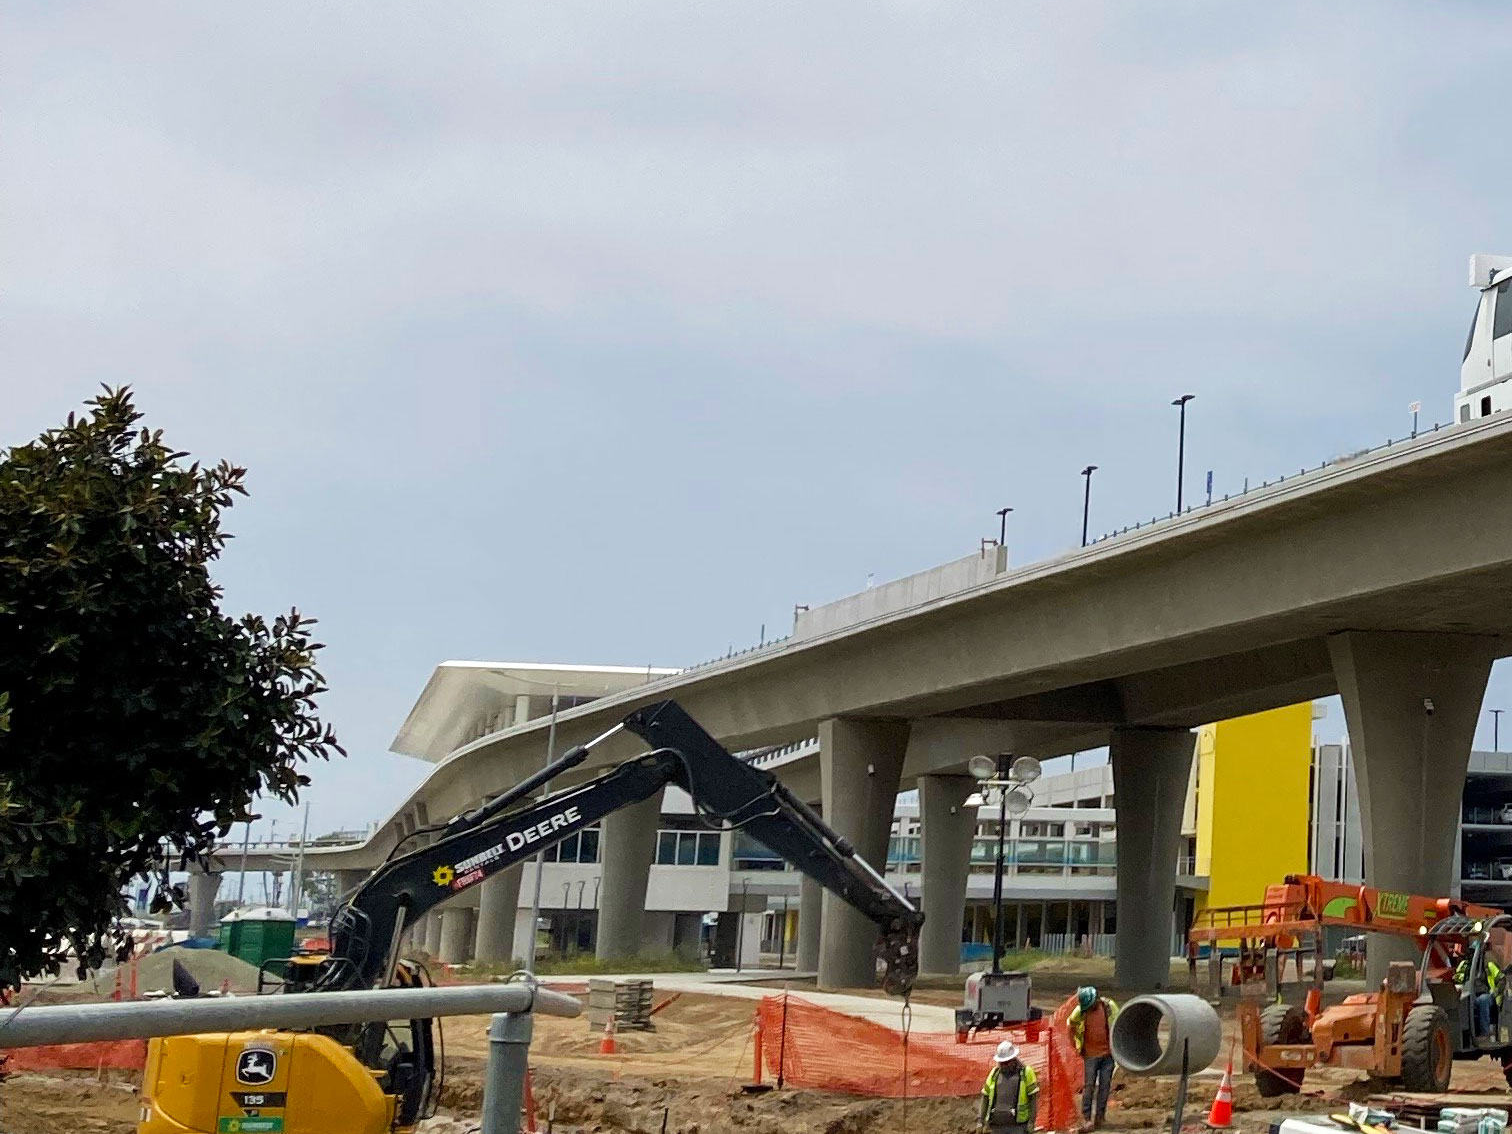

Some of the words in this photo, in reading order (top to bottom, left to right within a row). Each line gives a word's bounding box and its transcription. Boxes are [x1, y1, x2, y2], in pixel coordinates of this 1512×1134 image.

[505, 806, 582, 852] DEERE
[454, 842, 506, 874] SUNBELT
[244, 1095, 264, 1105] 135
